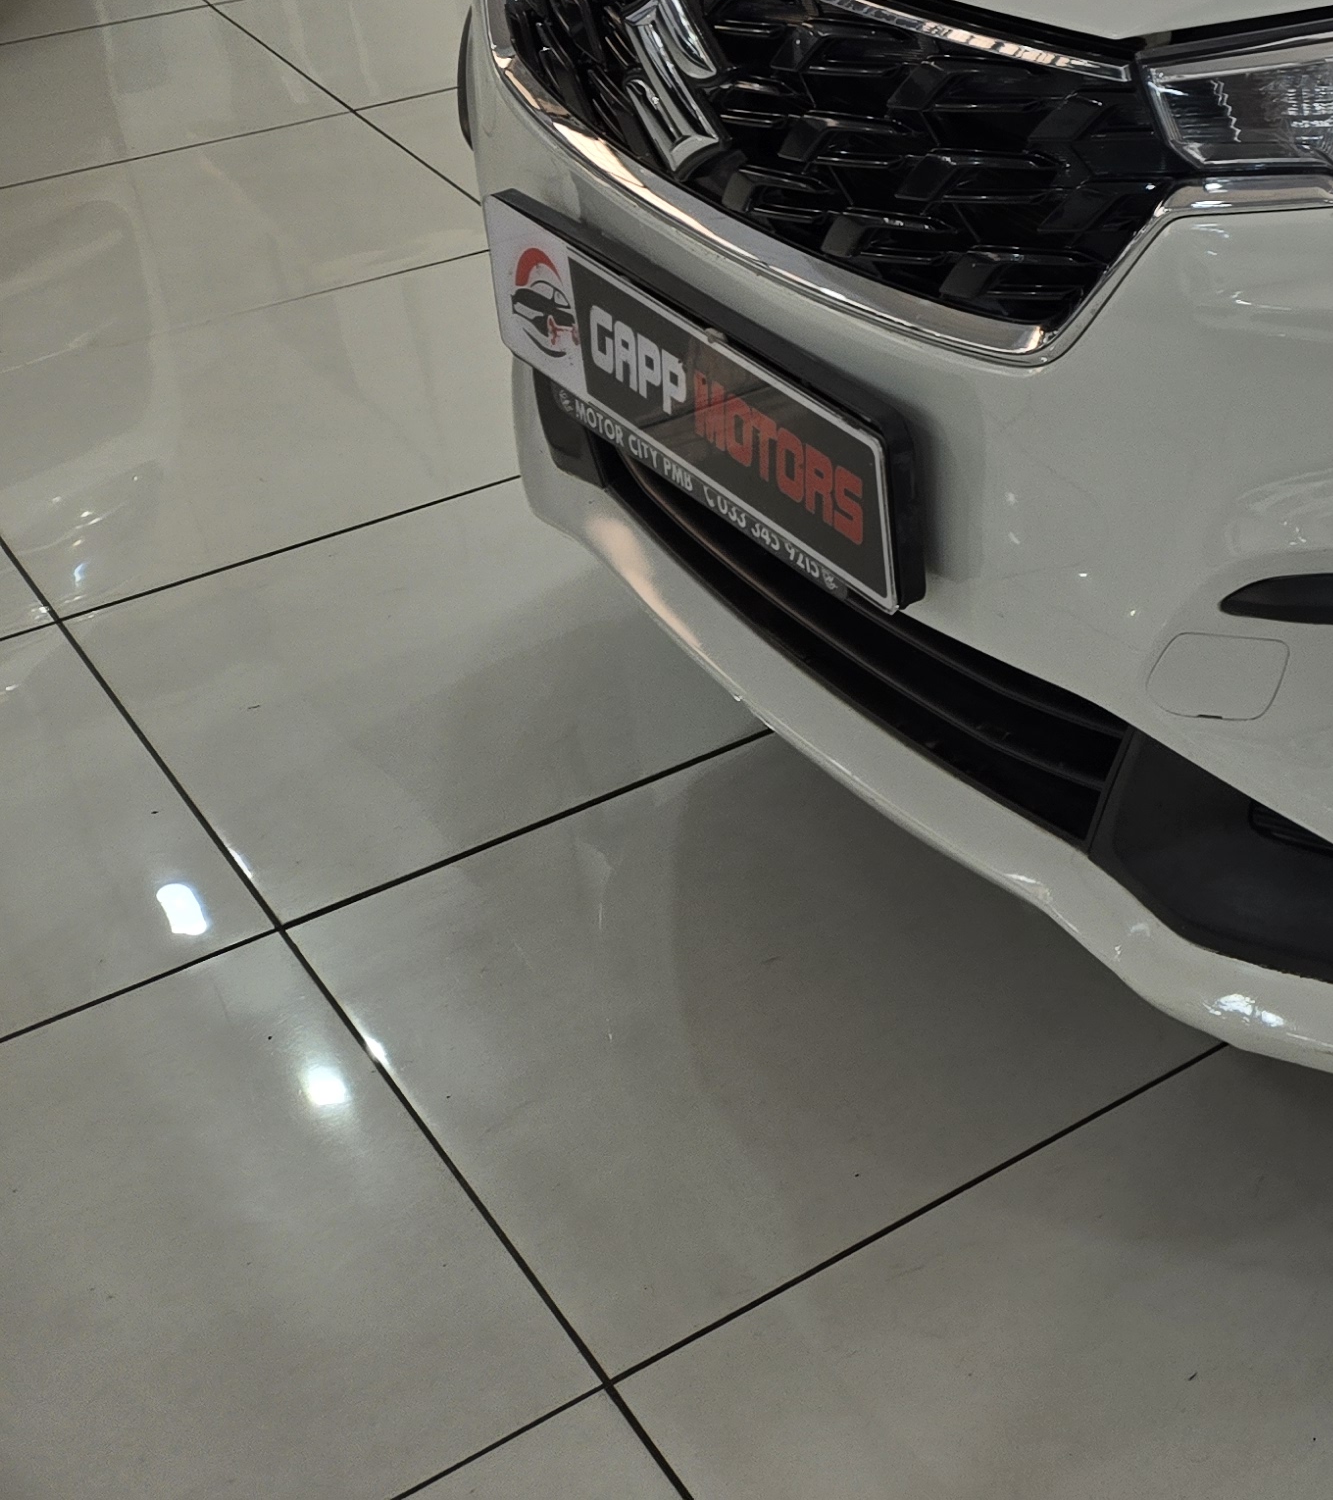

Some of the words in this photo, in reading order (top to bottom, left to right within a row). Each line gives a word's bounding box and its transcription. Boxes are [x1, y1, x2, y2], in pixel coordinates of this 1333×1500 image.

[575, 399, 625, 448] MOTOR
[628, 434, 658, 469] CITY
[590, 305, 687, 416] GAPP
[694, 370, 864, 544] MOTORS
